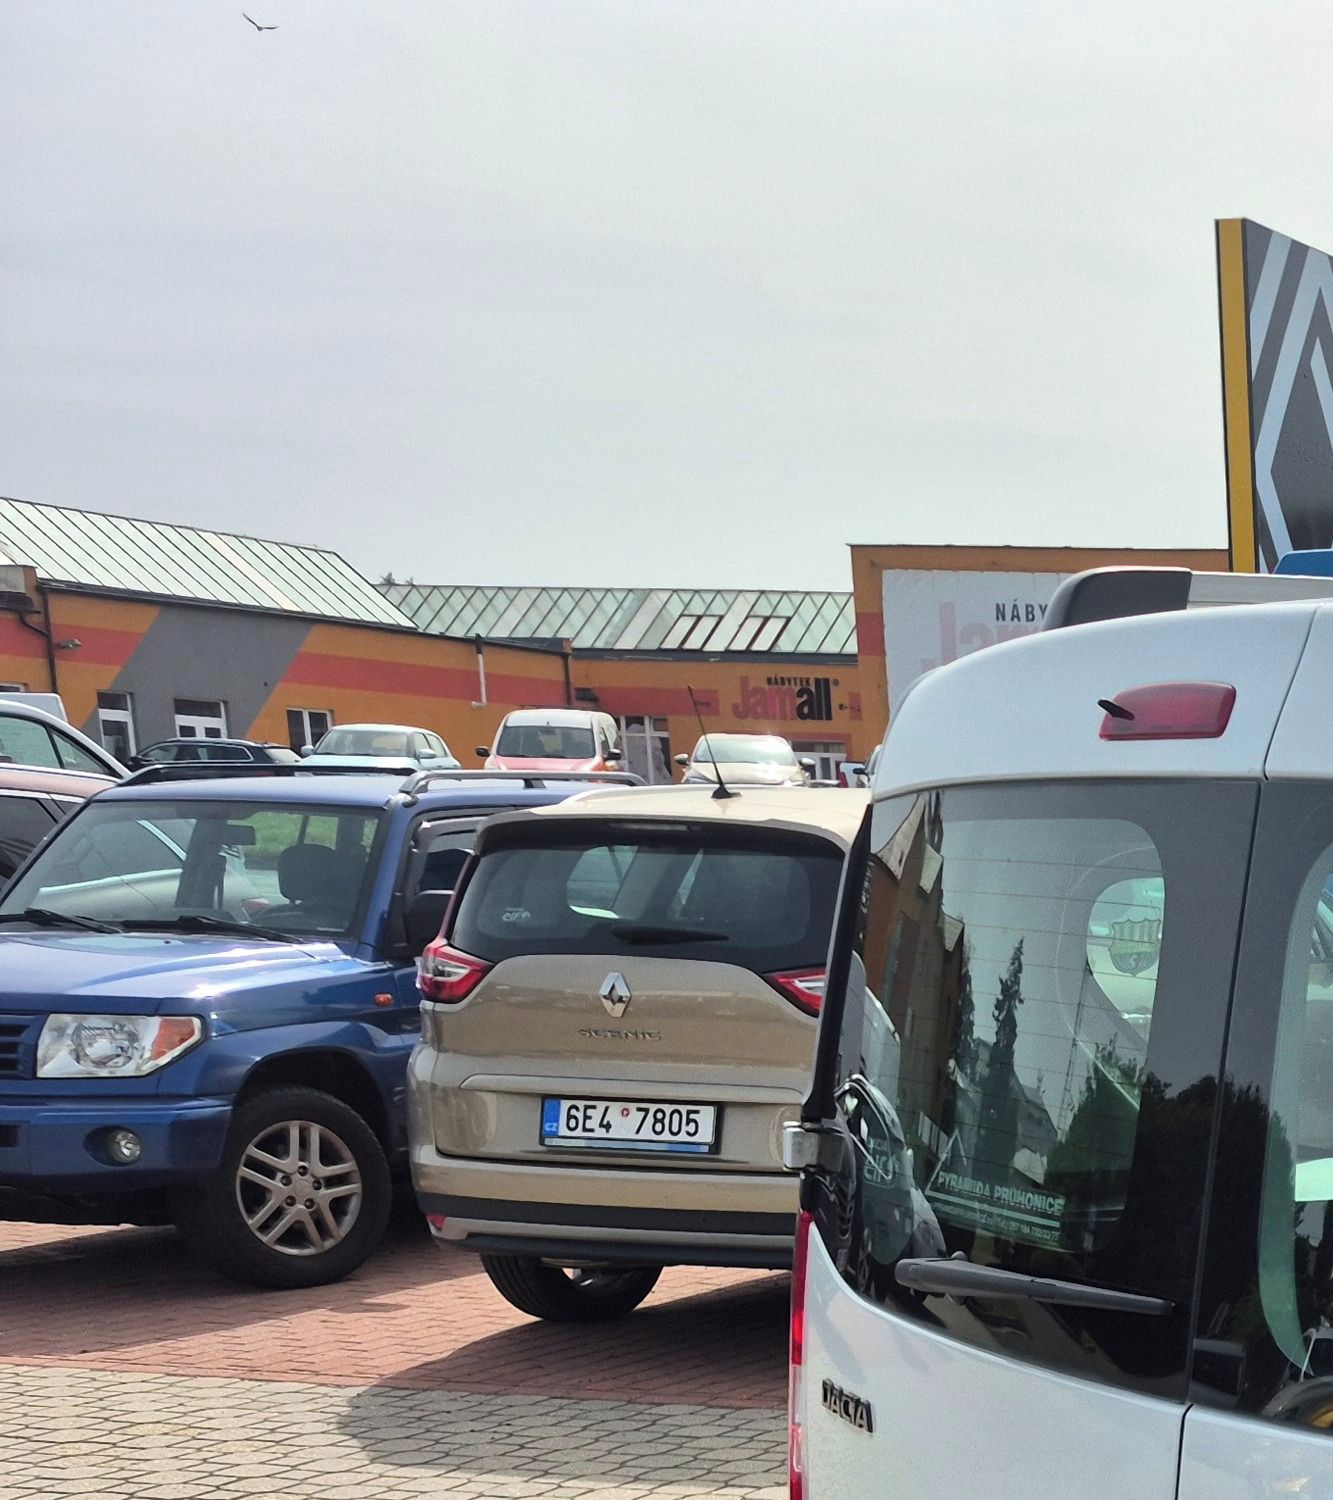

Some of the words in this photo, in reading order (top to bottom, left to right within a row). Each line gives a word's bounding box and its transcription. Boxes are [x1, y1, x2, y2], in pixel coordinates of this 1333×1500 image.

[995, 598, 1049, 622] NÁBY
[731, 675, 833, 721] Jamall
[565, 1104, 612, 1134] 6E4
[635, 1106, 701, 1137] 7805
